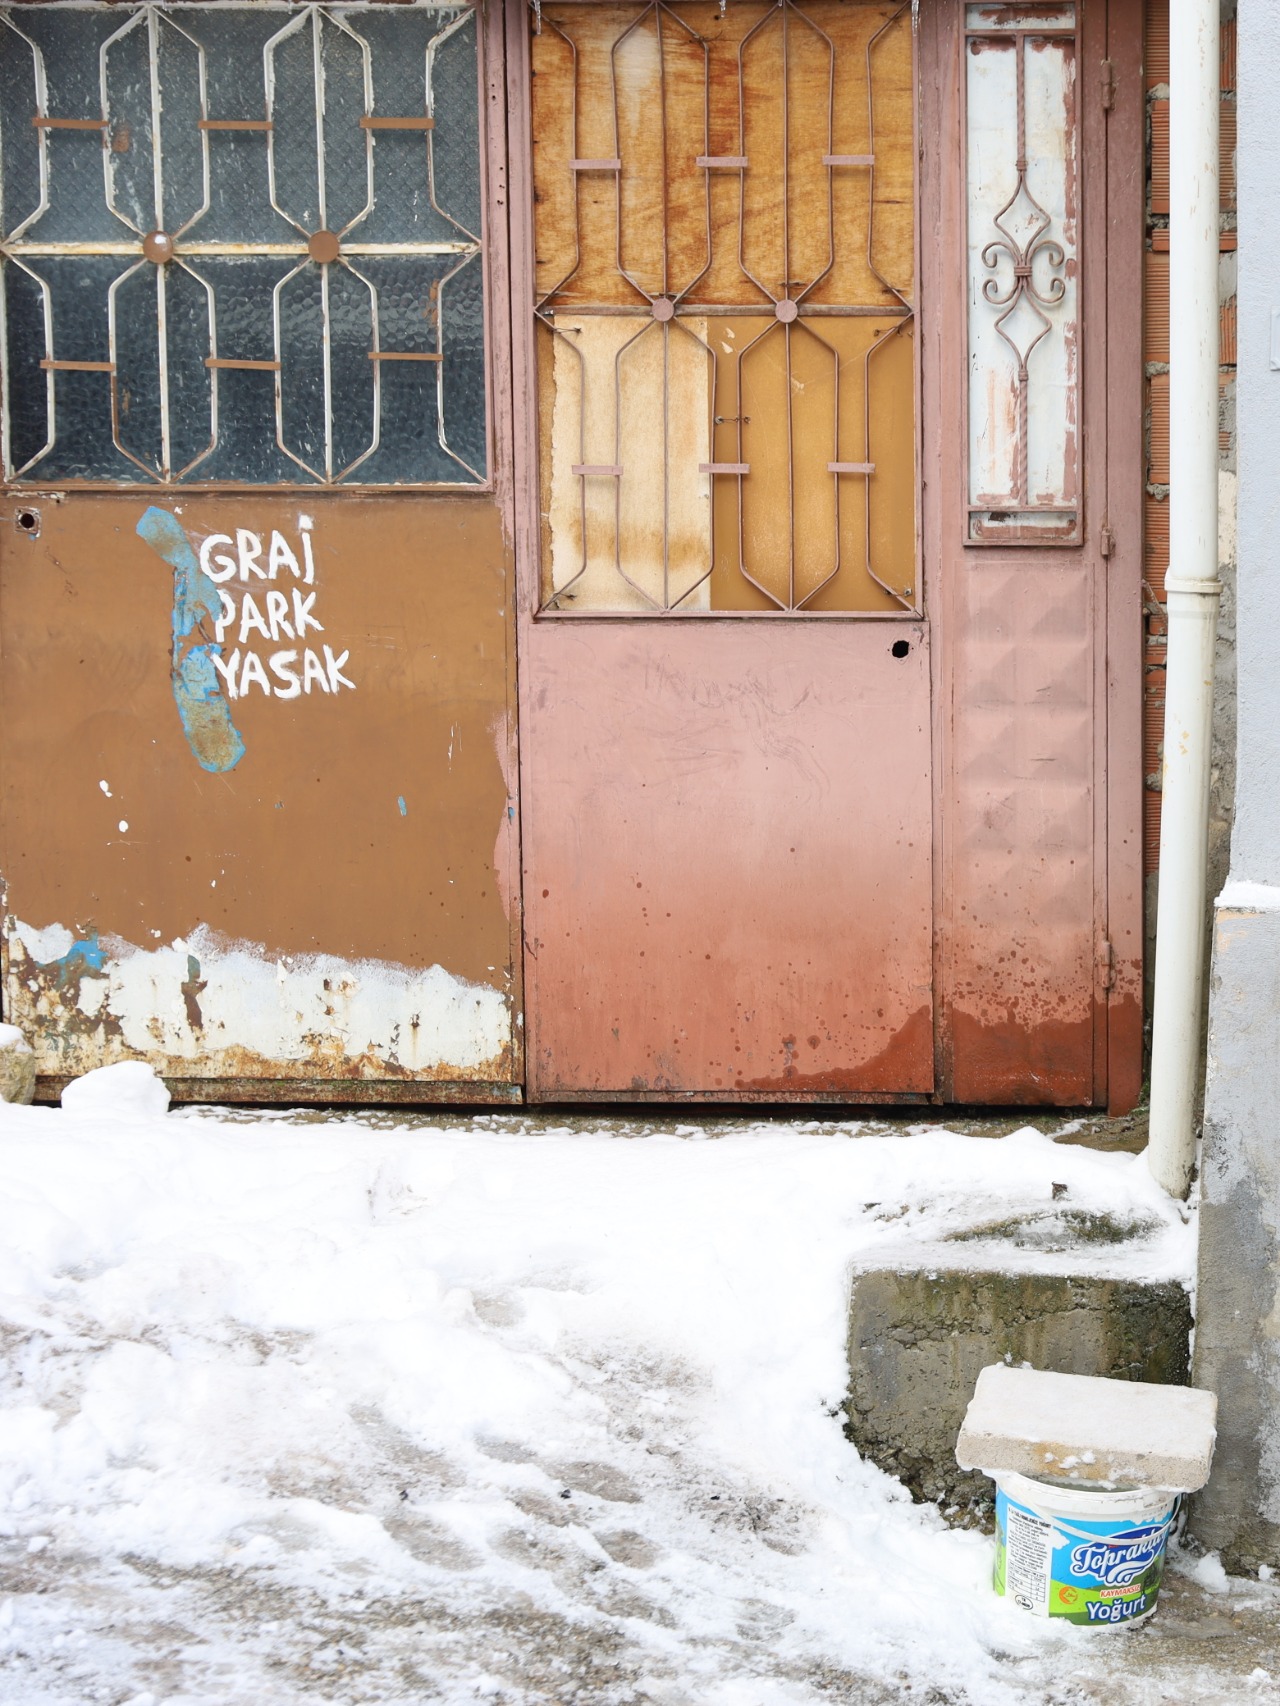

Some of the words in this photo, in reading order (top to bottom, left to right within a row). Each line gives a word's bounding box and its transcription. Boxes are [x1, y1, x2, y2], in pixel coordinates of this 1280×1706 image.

[215, 586, 325, 643] PARK
[210, 644, 357, 700] YASAK
[1087, 1593, 1147, 1622] Yoğurt
